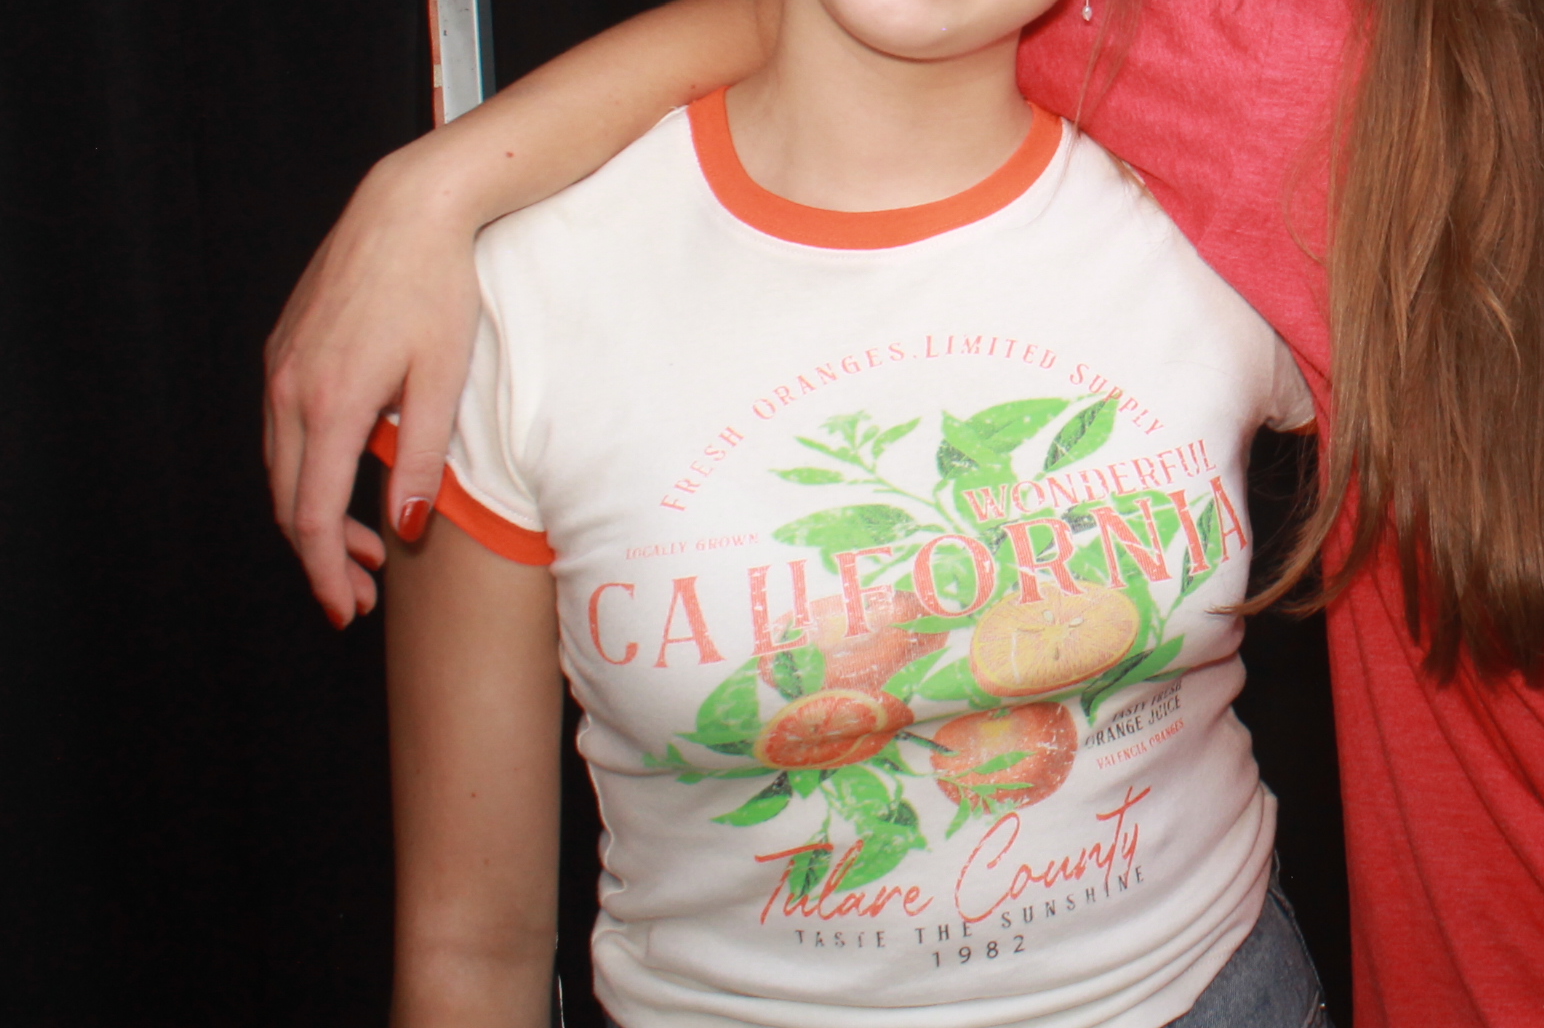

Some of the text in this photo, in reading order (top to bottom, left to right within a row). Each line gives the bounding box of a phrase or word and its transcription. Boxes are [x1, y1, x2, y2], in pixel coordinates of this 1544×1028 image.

[660, 425, 745, 512] FRESH
[925, 334, 1058, 370] LIMITED
[1069, 362, 1165, 436] SUPPLY
[962, 438, 1217, 522] WONDERFUL
[587, 475, 1249, 670] CALIFORNIA
[625, 532, 759, 560] LOCALLY GROWN
[1084, 694, 1182, 749] ORANGE JUICE
[1096, 717, 1185, 770] VALENCIA ORANGES
[754, 784, 1152, 926] Tulare County
[795, 864, 1145, 949] TASTE THE SUNSHINE
[932, 933, 1026, 968] 1982
